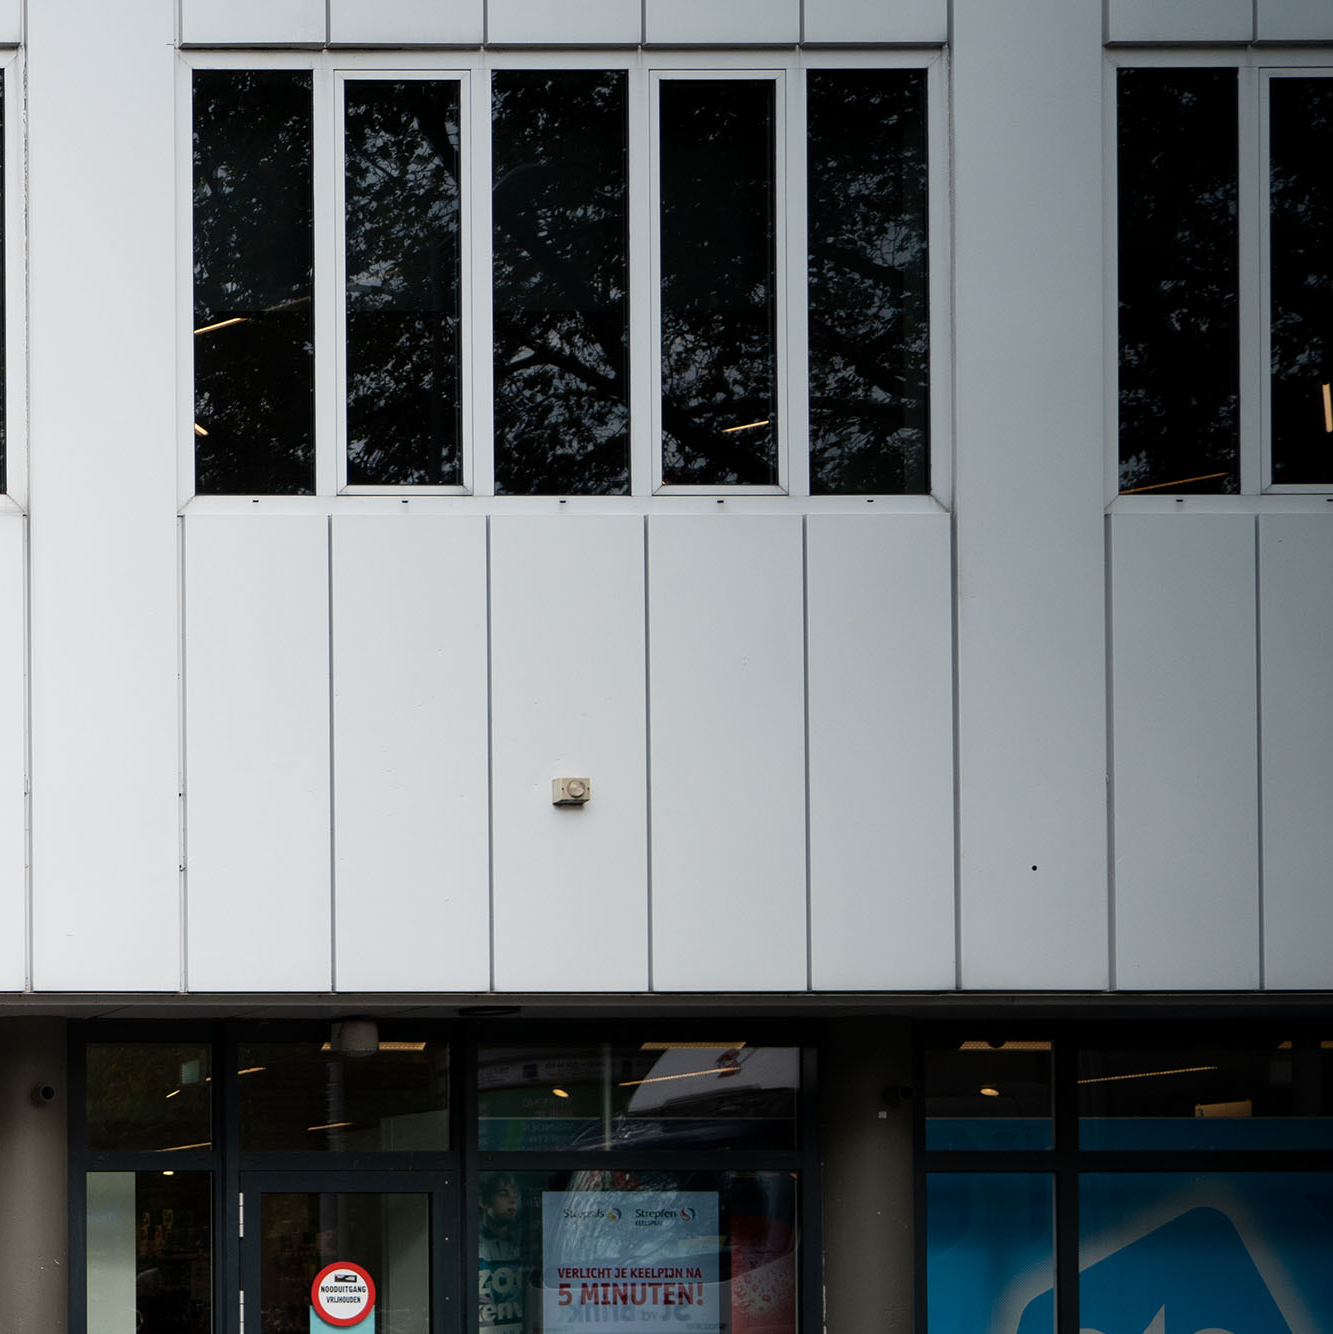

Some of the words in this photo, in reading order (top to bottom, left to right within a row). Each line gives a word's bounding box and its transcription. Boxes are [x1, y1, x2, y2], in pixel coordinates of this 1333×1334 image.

[635, 1208, 677, 1219] Strepfen
[557, 1268, 612, 1279] VERLICHT
[614, 1268, 627, 1279] JE
[630, 1268, 683, 1279] KEELPIJN
[686, 1268, 702, 1279] NA
[320, 1285, 367, 1293] NOODUITGANG
[558, 1283, 573, 1306] 5
[580, 1282, 704, 1306] MINUTEN!
